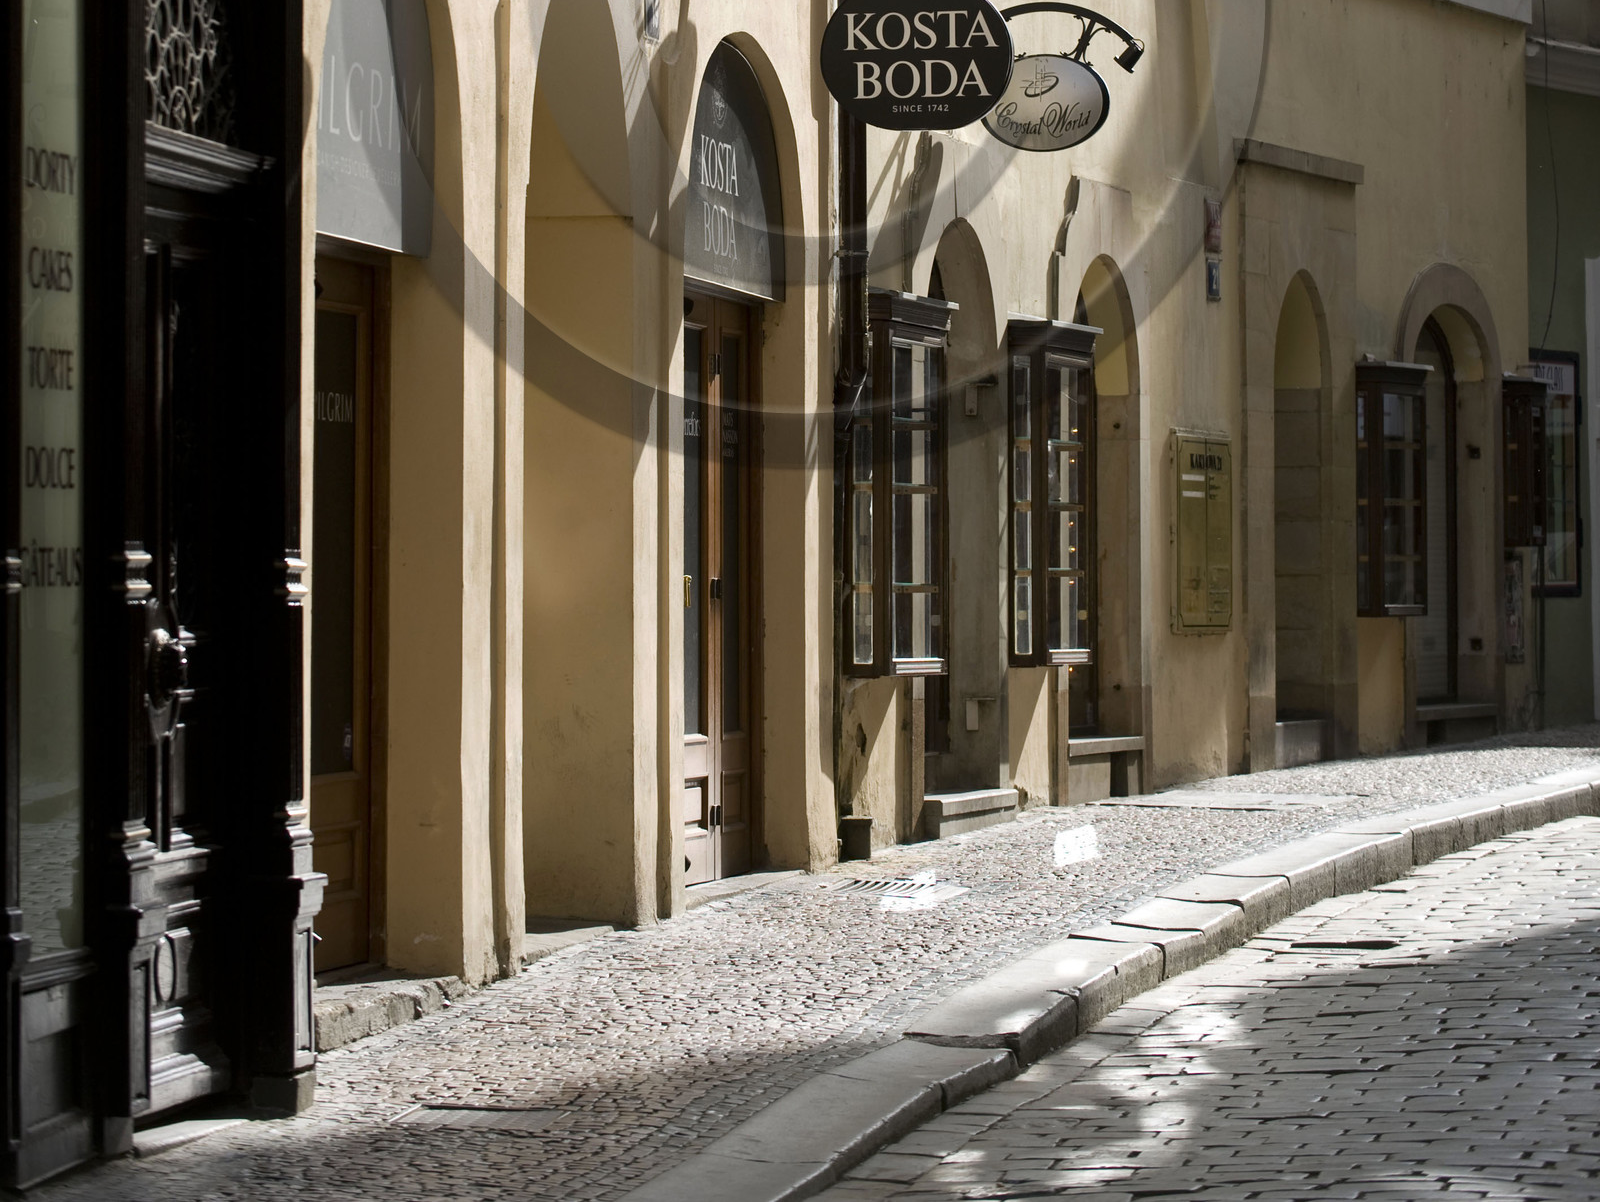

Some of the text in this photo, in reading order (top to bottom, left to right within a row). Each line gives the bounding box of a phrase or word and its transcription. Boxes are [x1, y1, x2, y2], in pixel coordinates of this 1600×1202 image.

[843, 10, 1000, 51] KOSTA
[853, 59, 993, 100] BODA
[318, 54, 422, 158] ILGRIM
[892, 103, 950, 114] SINCE 1742
[994, 101, 1092, 139] Crystal World
[26, 146, 77, 196] DORTY
[700, 134, 740, 198] KOSTA
[702, 200, 738, 261] BODA
[28, 245, 73, 293] CAKES
[27, 346, 74, 390] TORTE
[25, 445, 75, 489] DOLCE
